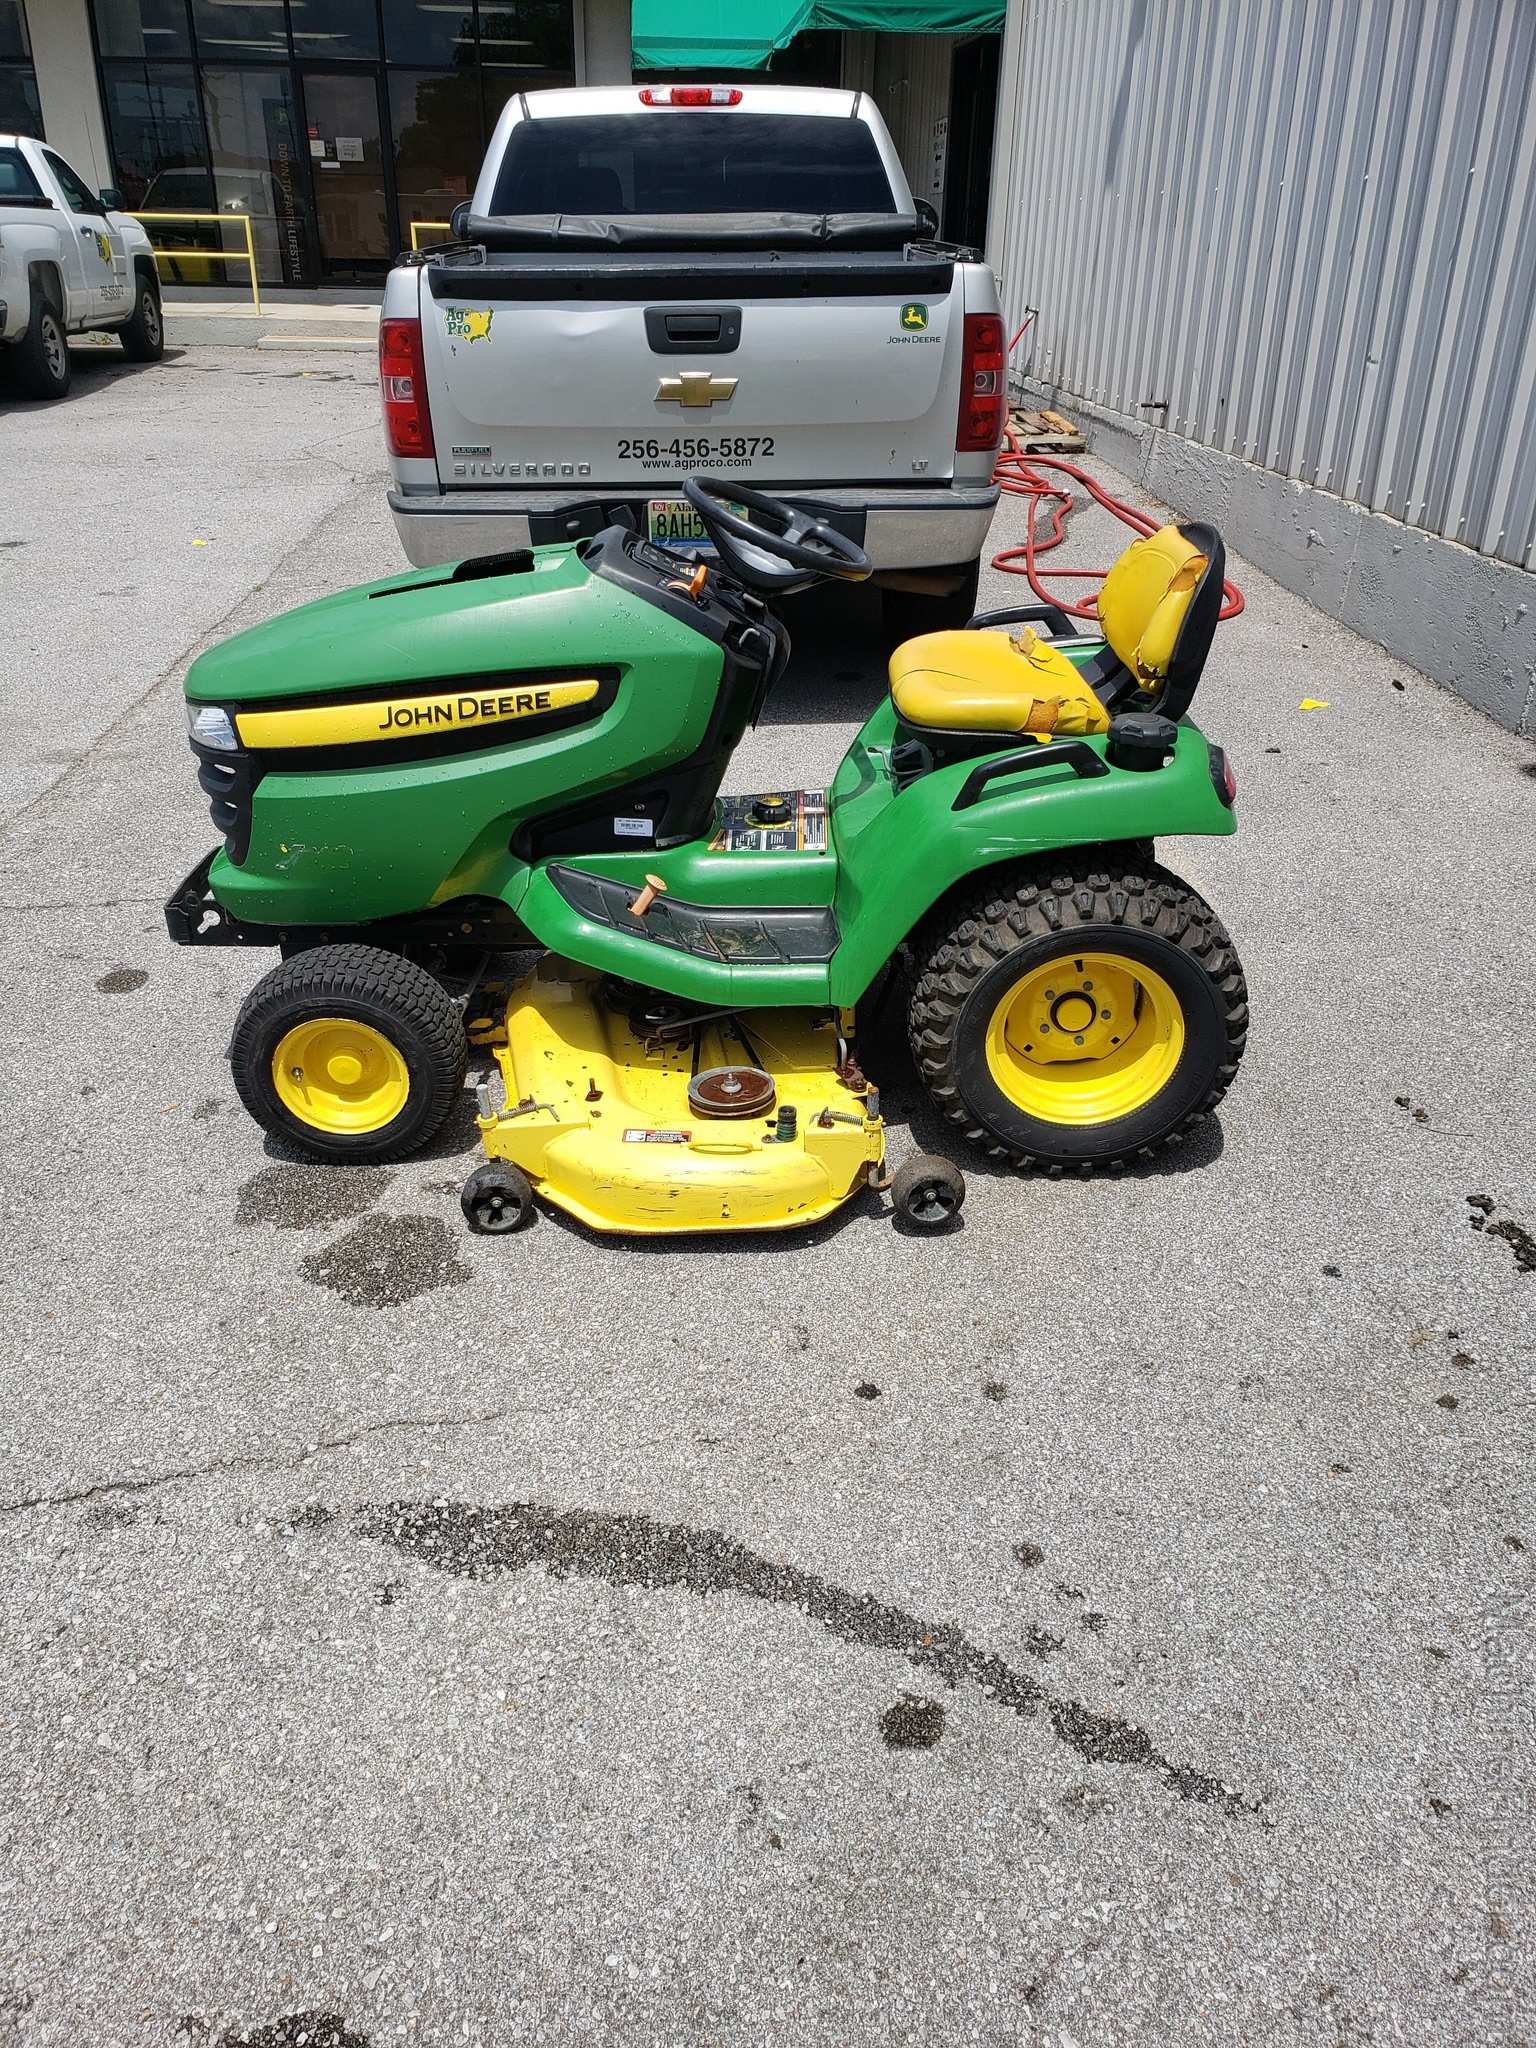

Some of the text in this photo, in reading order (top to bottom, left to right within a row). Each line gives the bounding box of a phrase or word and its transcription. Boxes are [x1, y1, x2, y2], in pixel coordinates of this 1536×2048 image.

[278, 143, 302, 281] DOWN TO EARTH LIFESTYLE
[446, 308, 470, 323] Ag-
[447, 322, 471, 335] Pro
[886, 336, 911, 344] JOHN
[618, 438, 775, 459] 256-456-5872
[454, 463, 592, 477] SILVERADO
[642, 457, 752, 470] www.agproco.com
[912, 460, 929, 473] LT
[654, 503, 665, 511] NOV
[656, 513, 709, 537] 8AH5
[379, 691, 551, 729] JOHN DEERE
